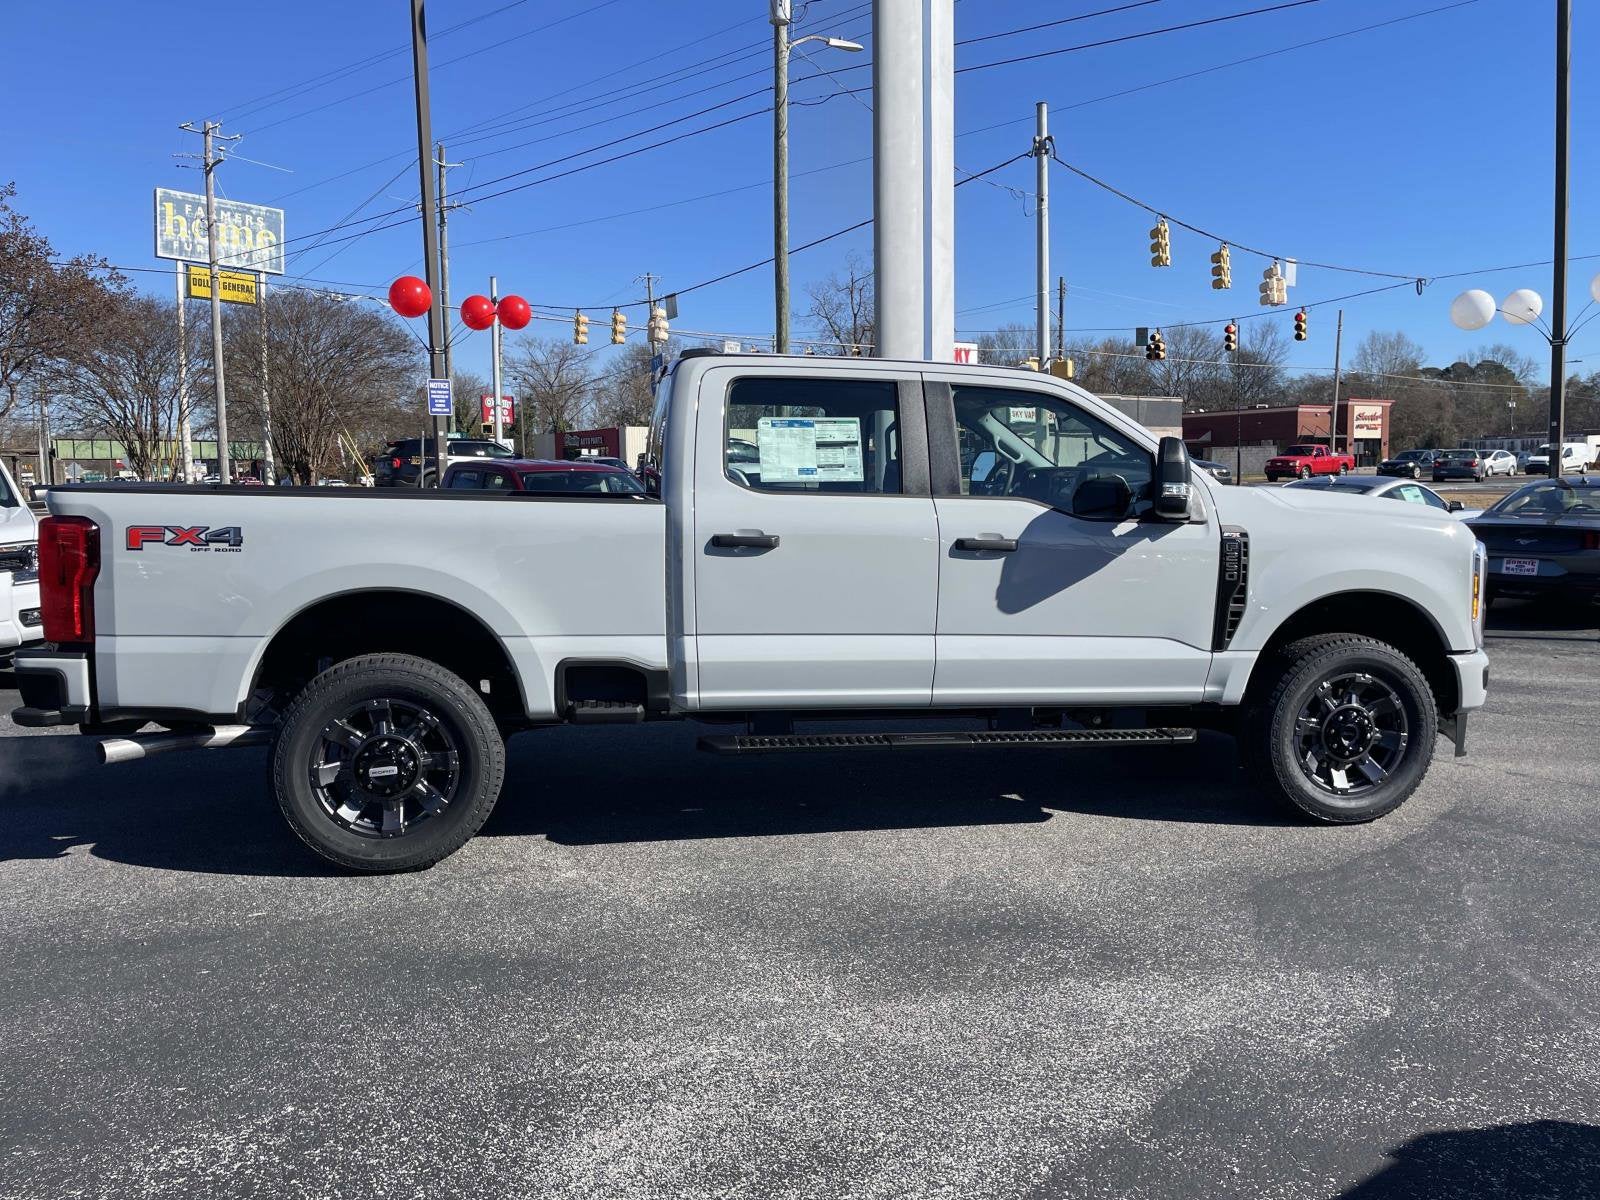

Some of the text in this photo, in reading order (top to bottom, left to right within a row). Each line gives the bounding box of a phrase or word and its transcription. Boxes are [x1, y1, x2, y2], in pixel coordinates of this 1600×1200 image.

[185, 203, 265, 228] FAMERS
[192, 278, 255, 295] DOLL GENERAL
[126, 525, 243, 551] FX4
